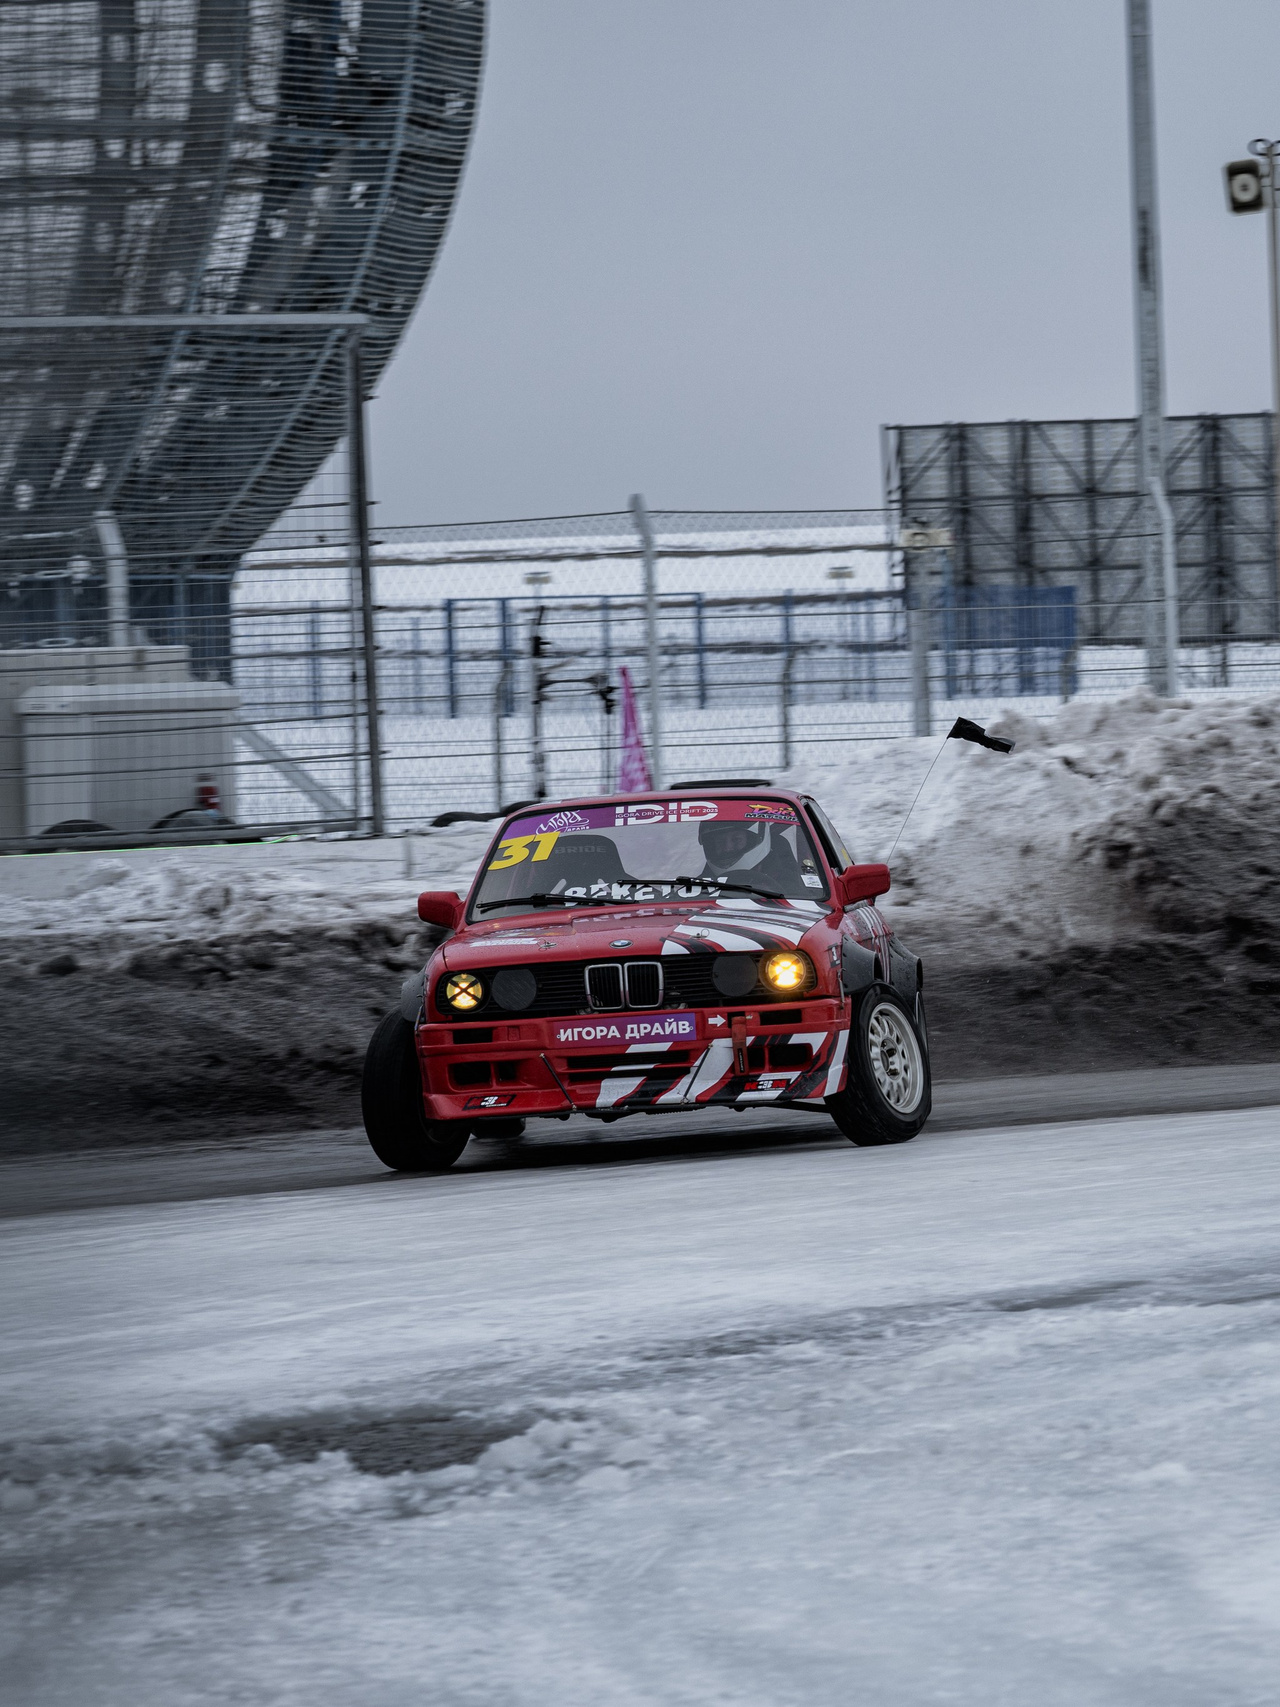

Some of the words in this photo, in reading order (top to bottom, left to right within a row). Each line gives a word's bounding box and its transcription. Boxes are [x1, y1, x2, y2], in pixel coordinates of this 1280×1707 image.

[615, 801, 719, 827] IDID
[487, 830, 561, 871] 31
[559, 1026, 621, 1042] ИГОРА
[625, 1018, 690, 1040] ДРАЙВ
